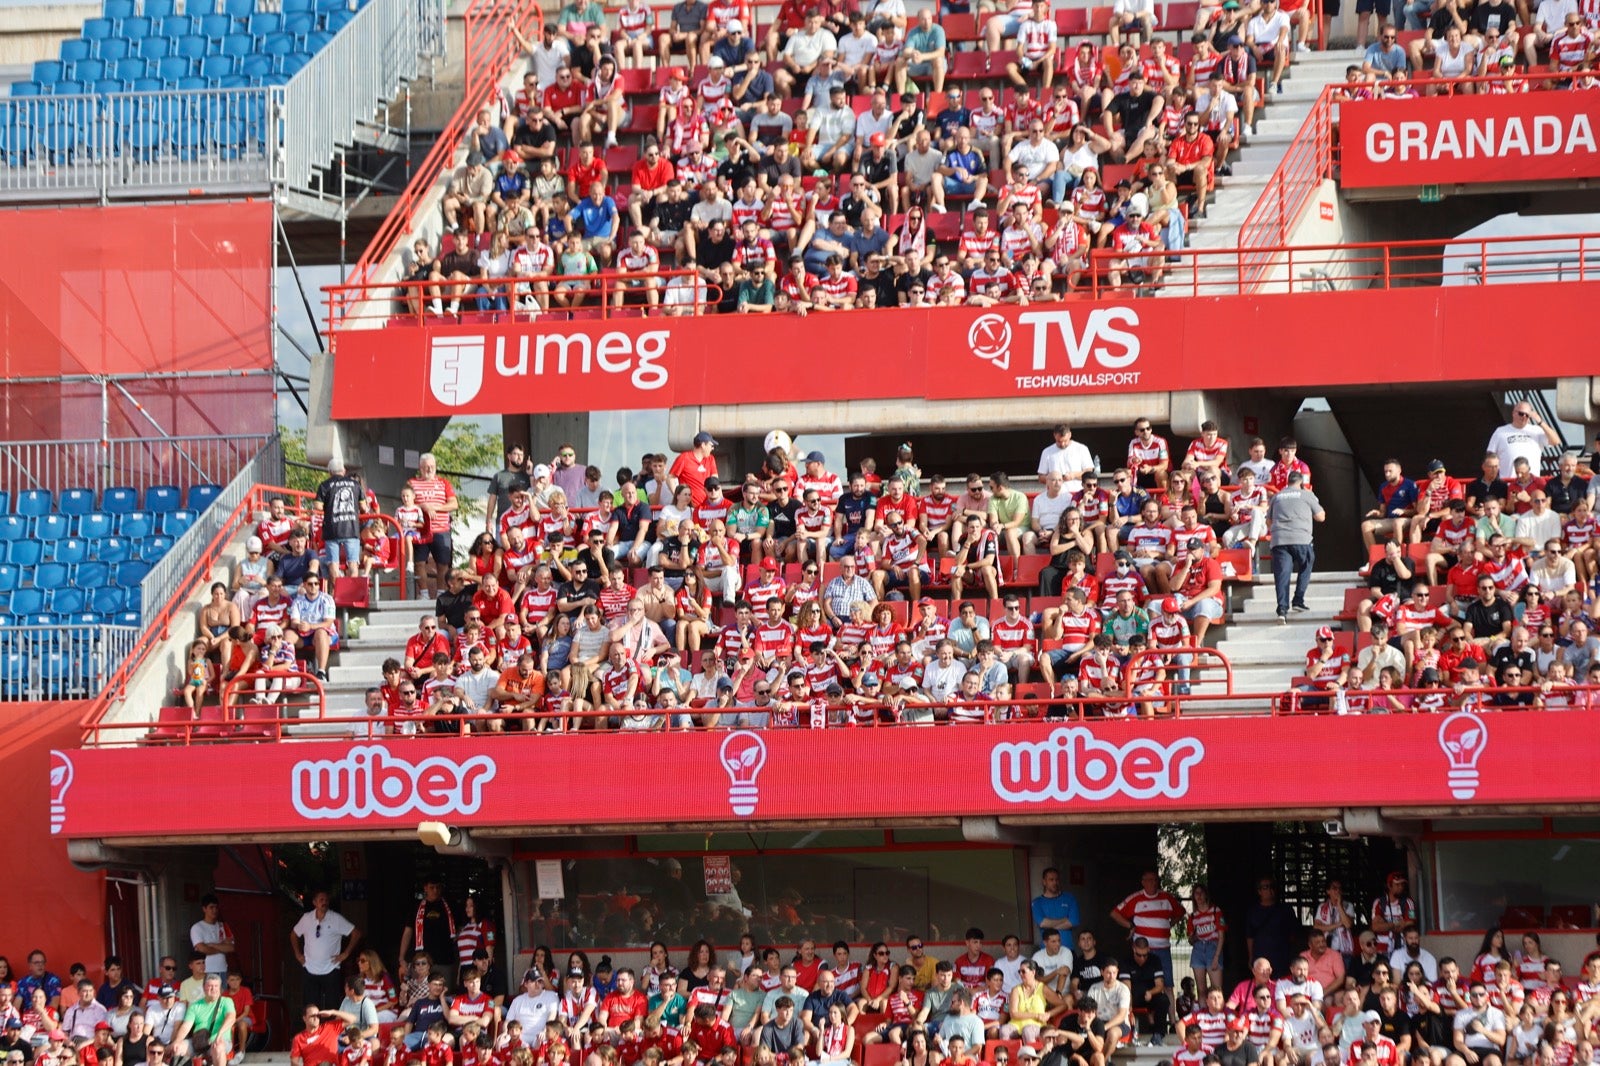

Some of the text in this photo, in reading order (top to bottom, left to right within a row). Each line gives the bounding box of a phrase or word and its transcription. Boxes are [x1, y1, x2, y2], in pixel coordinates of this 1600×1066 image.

[1365, 113, 1598, 163] GRANADA
[494, 329, 671, 390] umeg
[1018, 306, 1141, 371] TVS
[1015, 371, 1141, 389] TECHVISUALSPORT
[292, 745, 497, 819] wiber
[991, 727, 1205, 803] wiber
